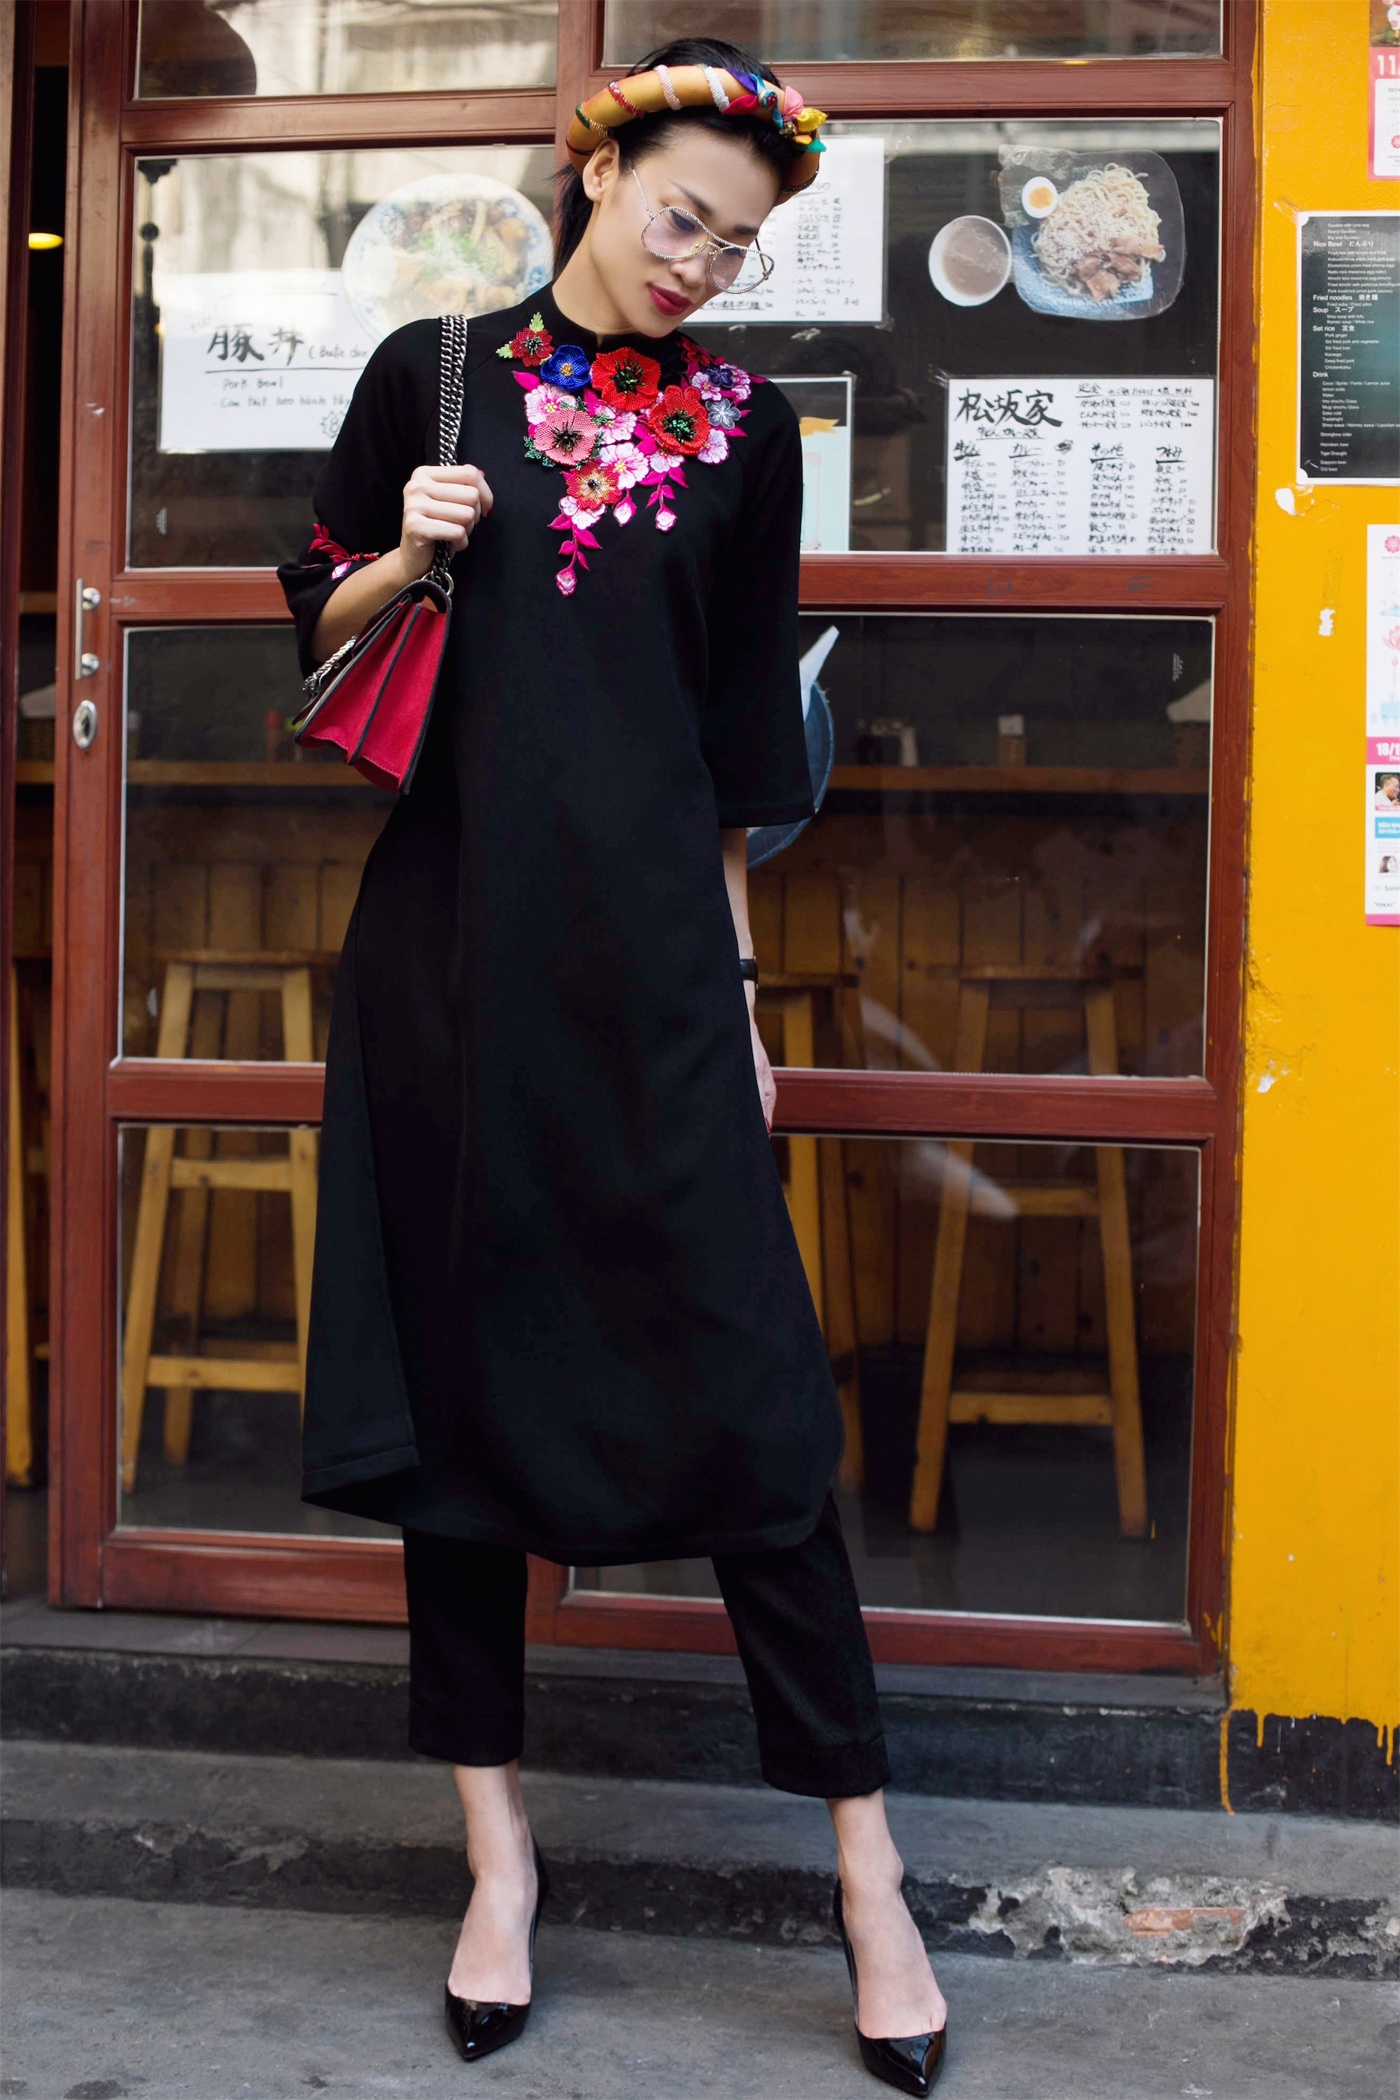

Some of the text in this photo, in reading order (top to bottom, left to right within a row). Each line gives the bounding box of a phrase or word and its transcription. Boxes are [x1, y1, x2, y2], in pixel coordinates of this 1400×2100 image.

[954, 388, 1062, 427] 松坂家
[1012, 442, 1042, 455] カレー
